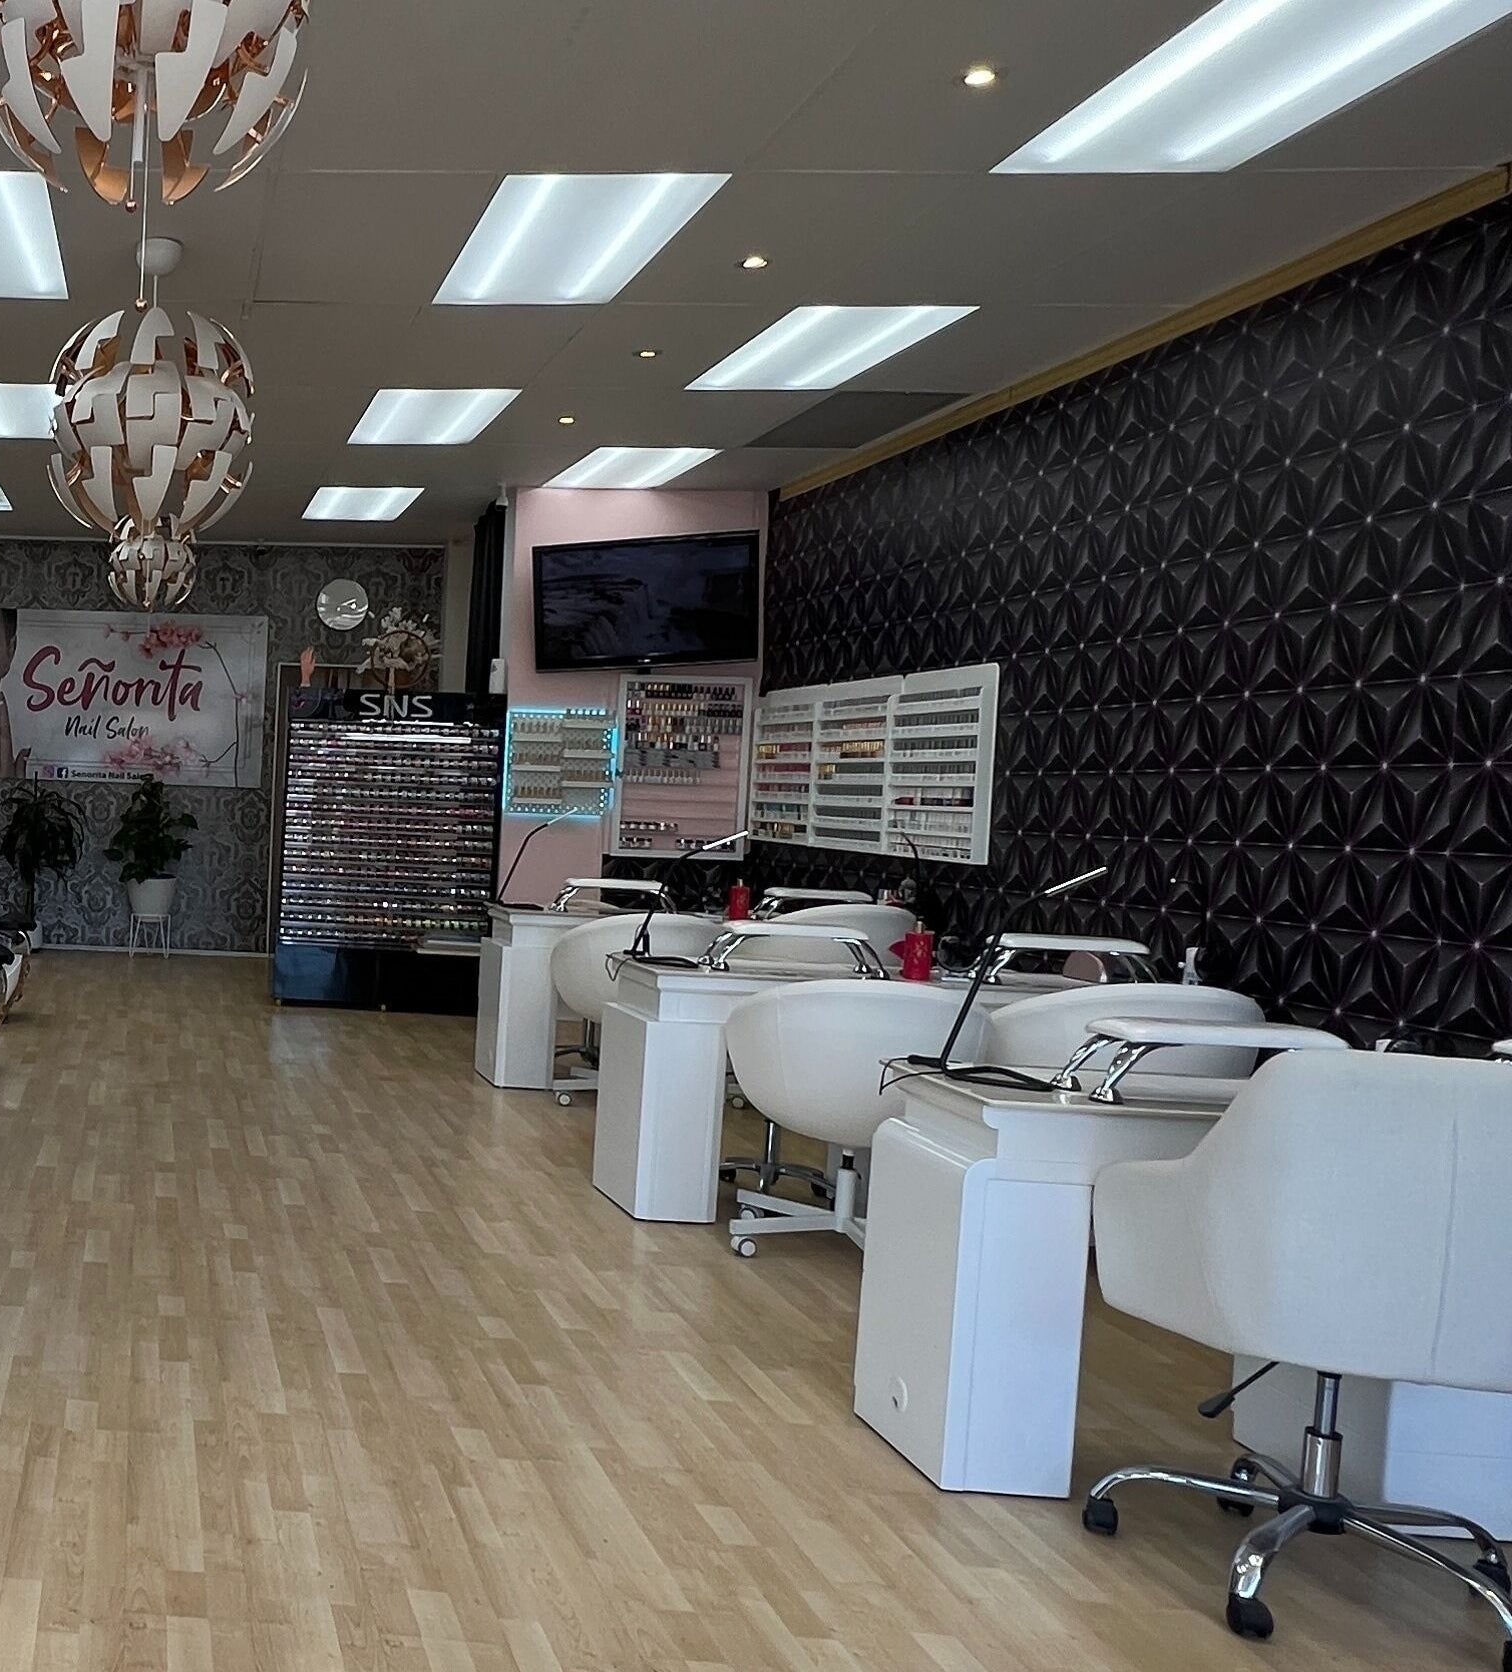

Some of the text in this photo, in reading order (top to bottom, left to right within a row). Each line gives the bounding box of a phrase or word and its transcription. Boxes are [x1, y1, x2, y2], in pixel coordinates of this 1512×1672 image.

[22, 645, 204, 722] Señorita
[359, 694, 433, 718] SNS
[64, 715, 150, 740] Nail Salon
